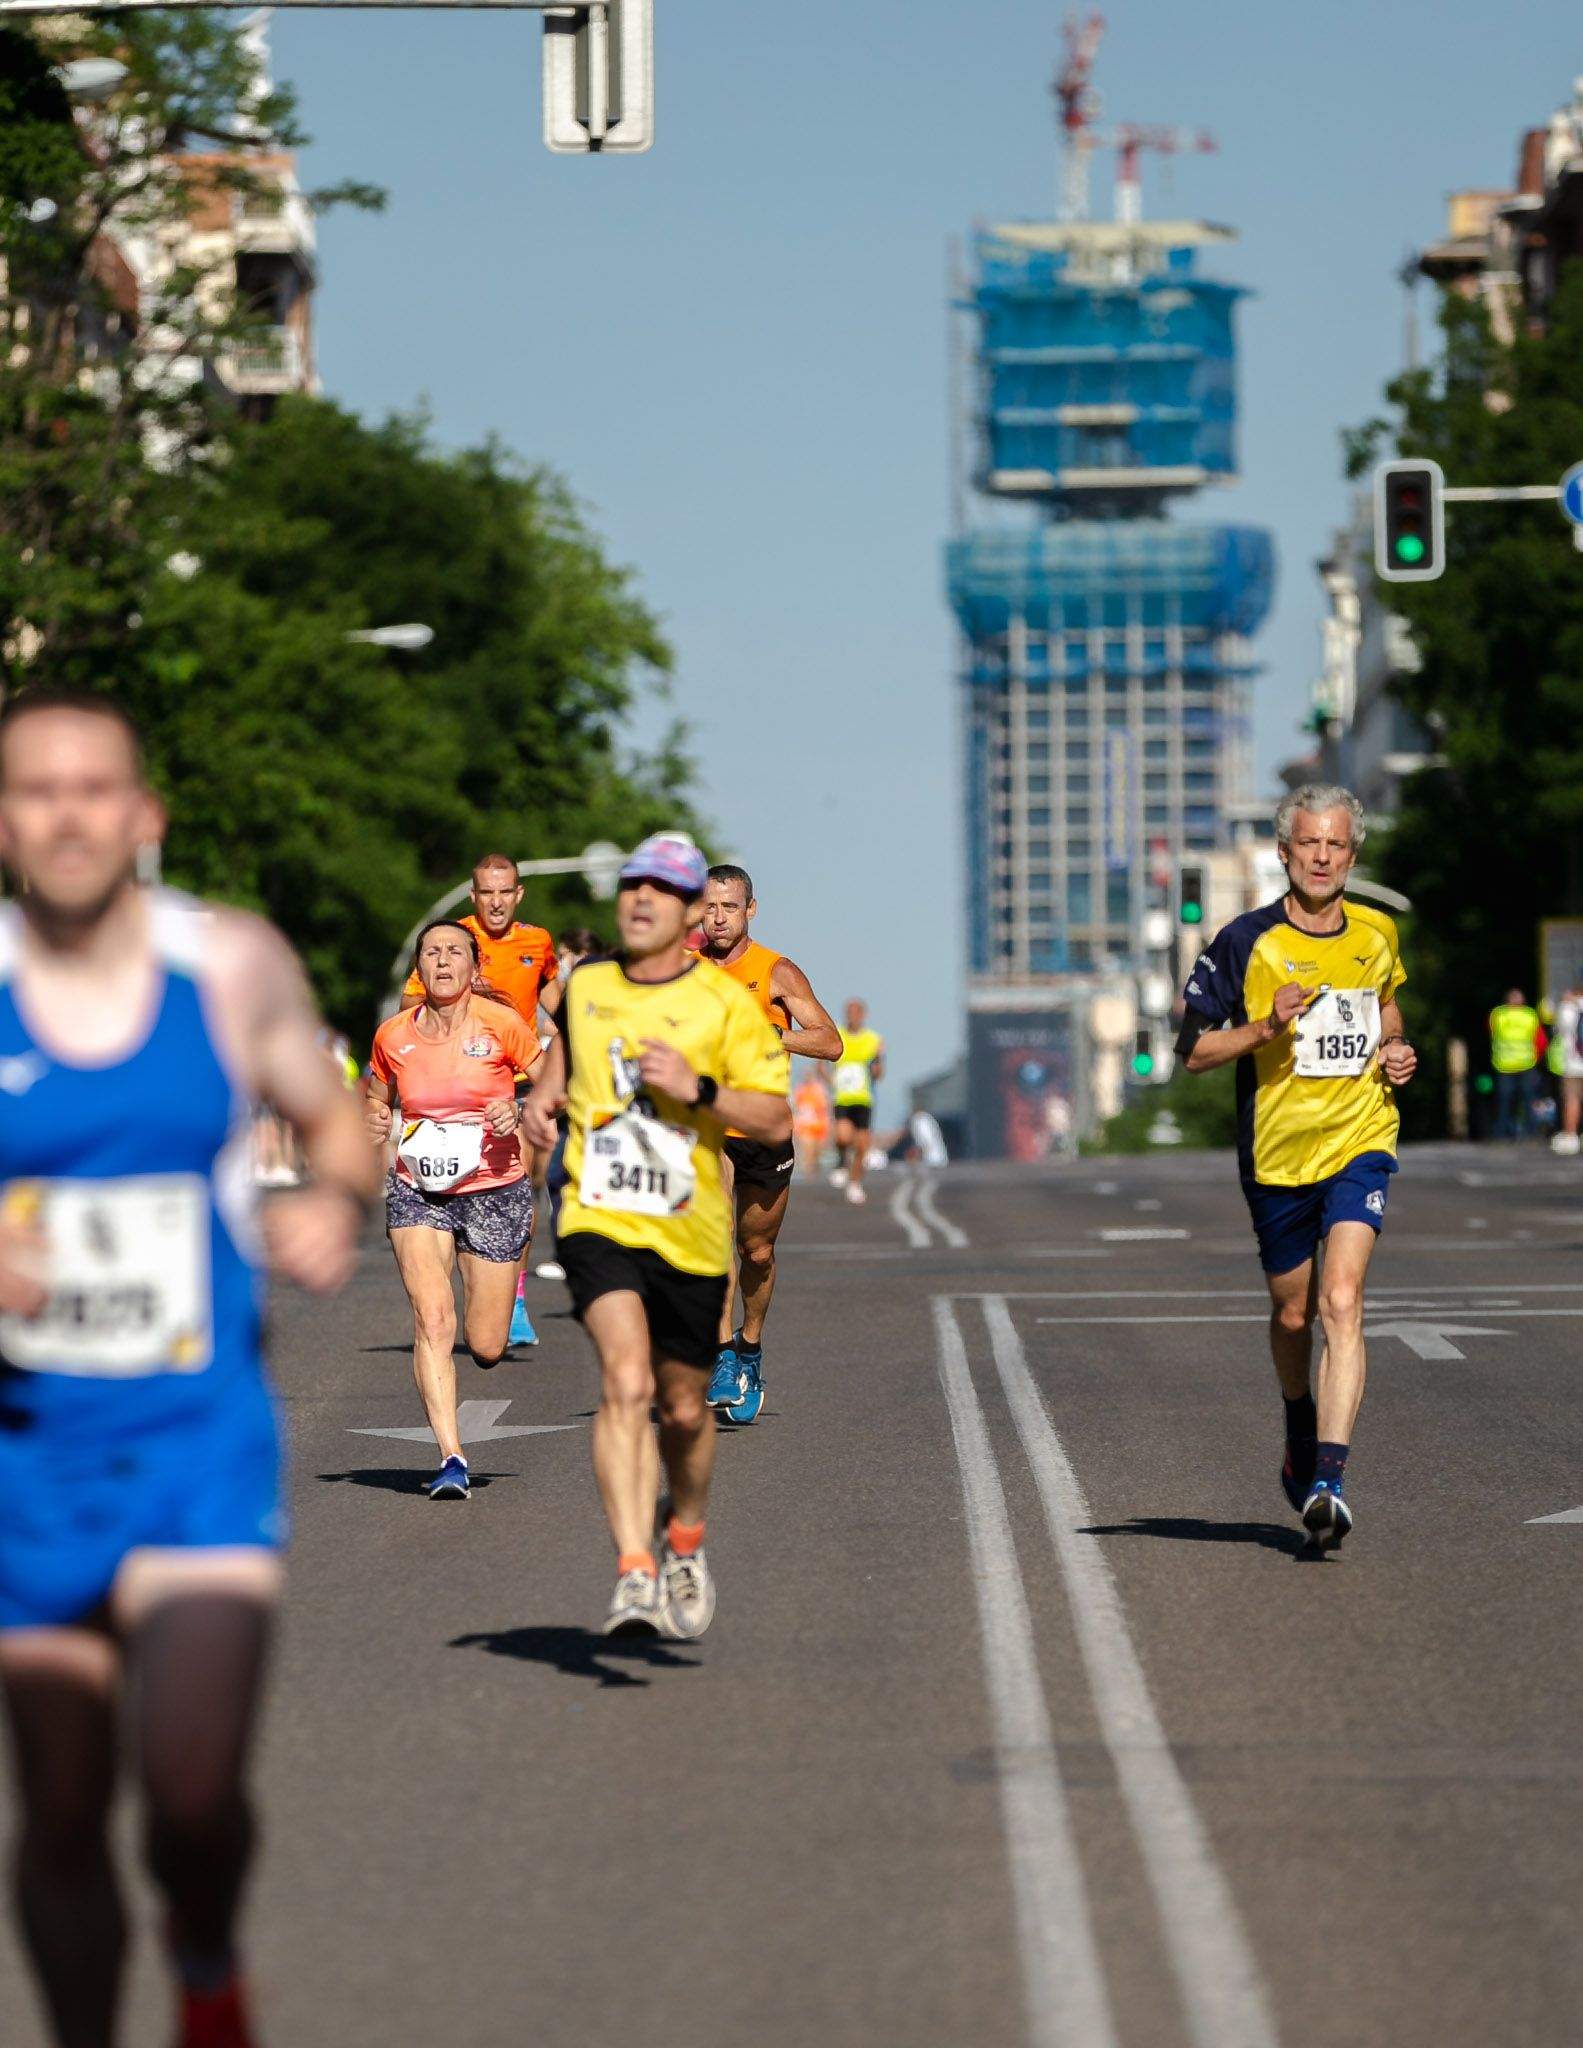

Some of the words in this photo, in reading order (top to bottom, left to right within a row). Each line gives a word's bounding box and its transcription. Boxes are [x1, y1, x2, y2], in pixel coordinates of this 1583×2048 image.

[1316, 1034, 1368, 1060] 1352
[419, 1156, 459, 1178] 685
[609, 1161, 668, 1194] 3411
